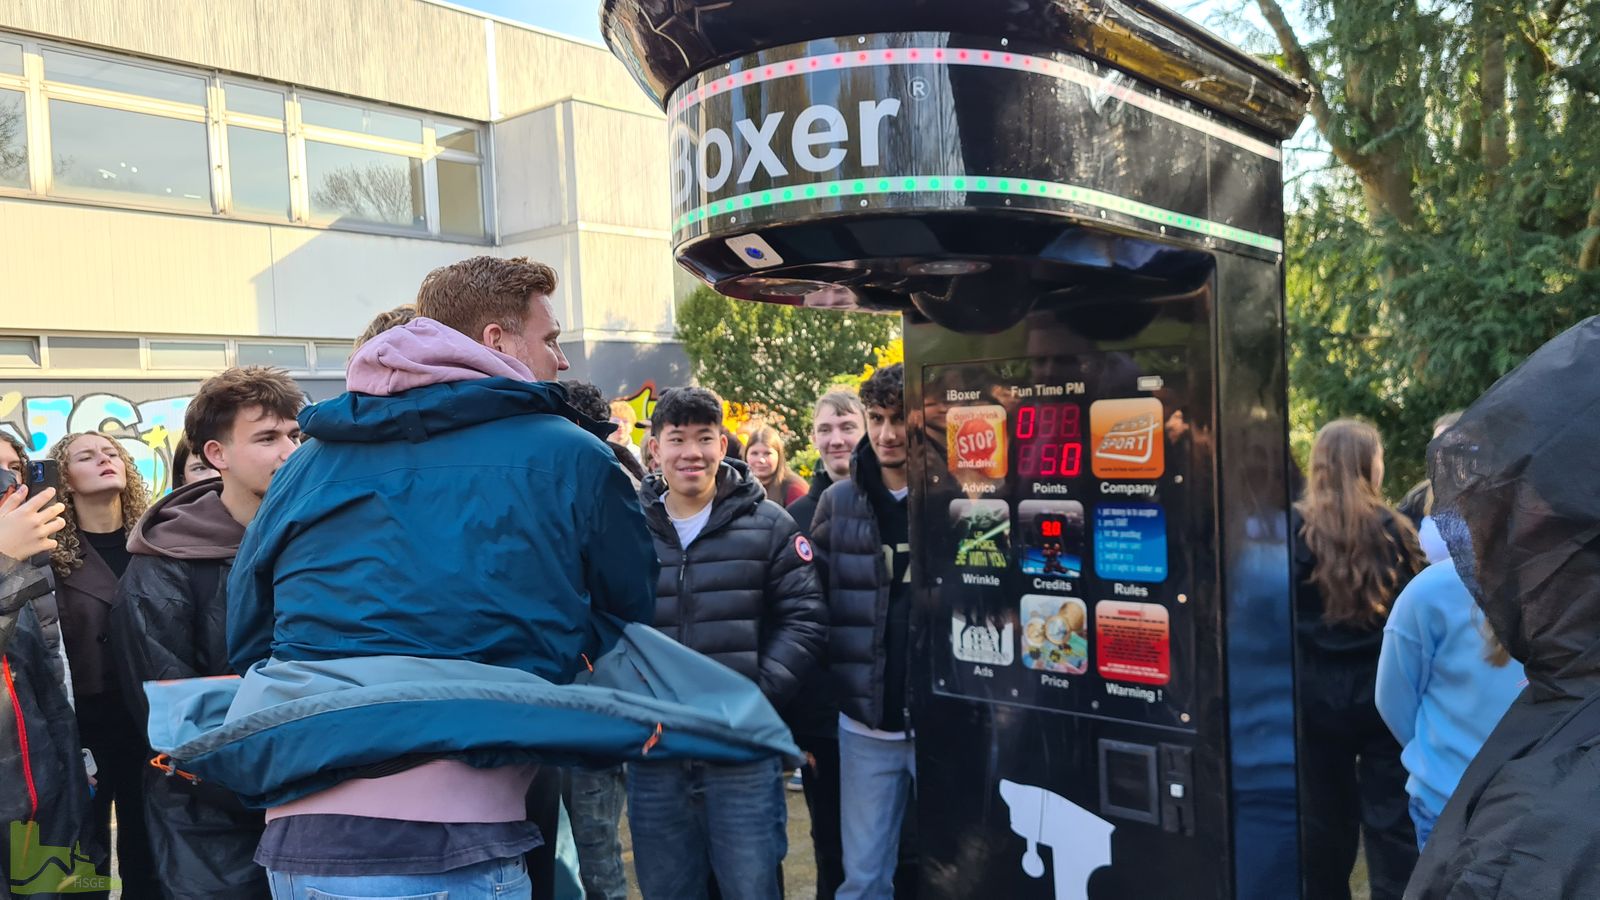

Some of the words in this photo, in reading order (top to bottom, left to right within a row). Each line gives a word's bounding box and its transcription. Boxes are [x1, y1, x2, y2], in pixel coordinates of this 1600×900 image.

[946, 389, 981, 401] iBoxer
[1011, 386, 1034, 398] Fun
[1035, 384, 1063, 396] Time
[1065, 382, 1085, 394] PM
[958, 430, 994, 455] STOP
[1101, 435, 1147, 451] SPORT
[962, 482, 996, 494] Advice
[1033, 482, 1068, 494] Points
[1100, 481, 1157, 496] Company
[962, 573, 1000, 586] Wrinkle
[1033, 577, 1072, 591] Credits
[1114, 583, 1149, 597] Rules
[973, 665, 994, 678] Ads
[1041, 674, 1069, 689] Price
[1106, 682, 1155, 703] Warning
